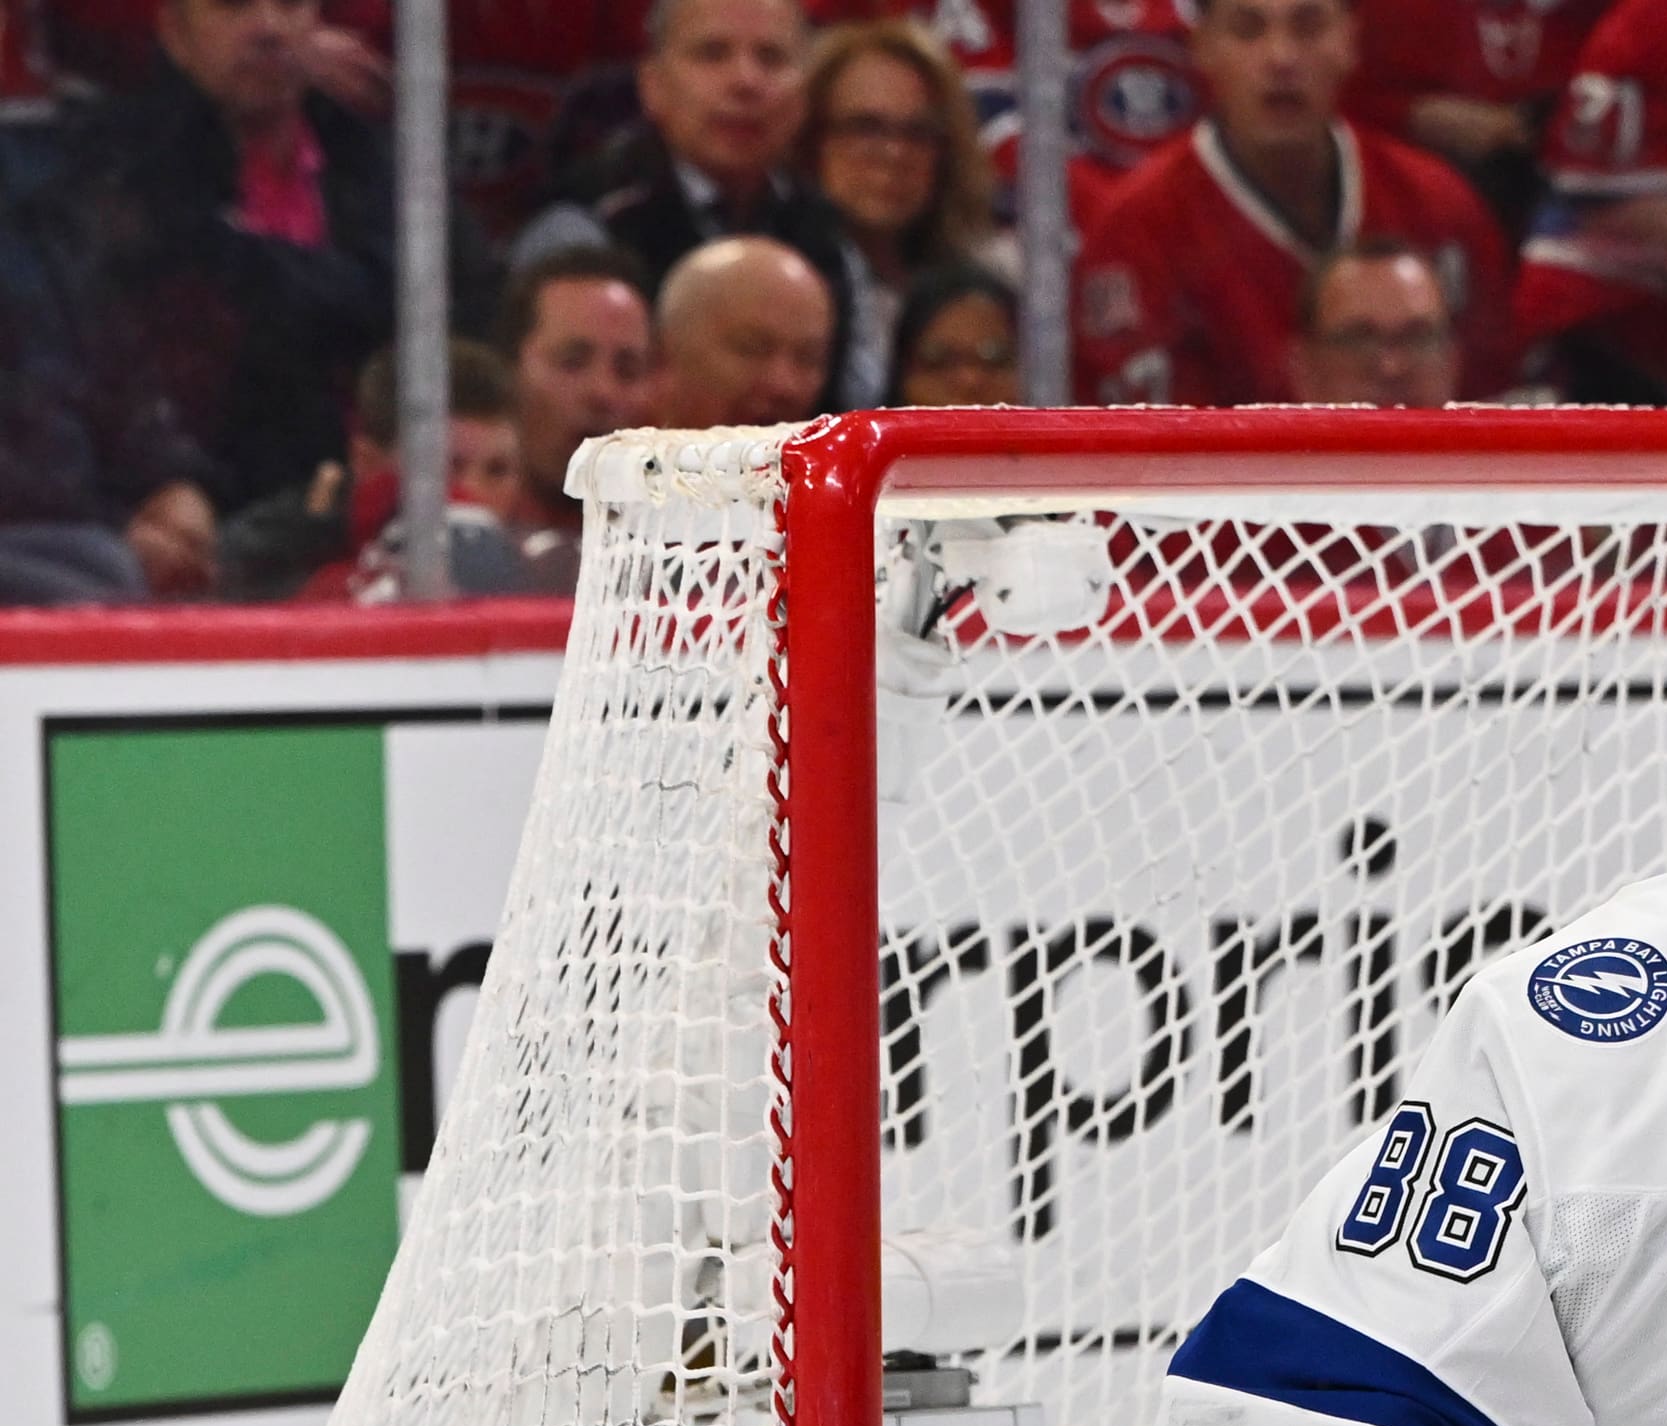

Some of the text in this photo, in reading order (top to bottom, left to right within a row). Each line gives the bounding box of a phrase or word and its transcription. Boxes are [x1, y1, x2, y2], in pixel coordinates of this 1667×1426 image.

[1543, 939, 1617, 969] TAMPA
[1623, 941, 1663, 965] BAY
[1335, 1100, 1528, 1284] 88
